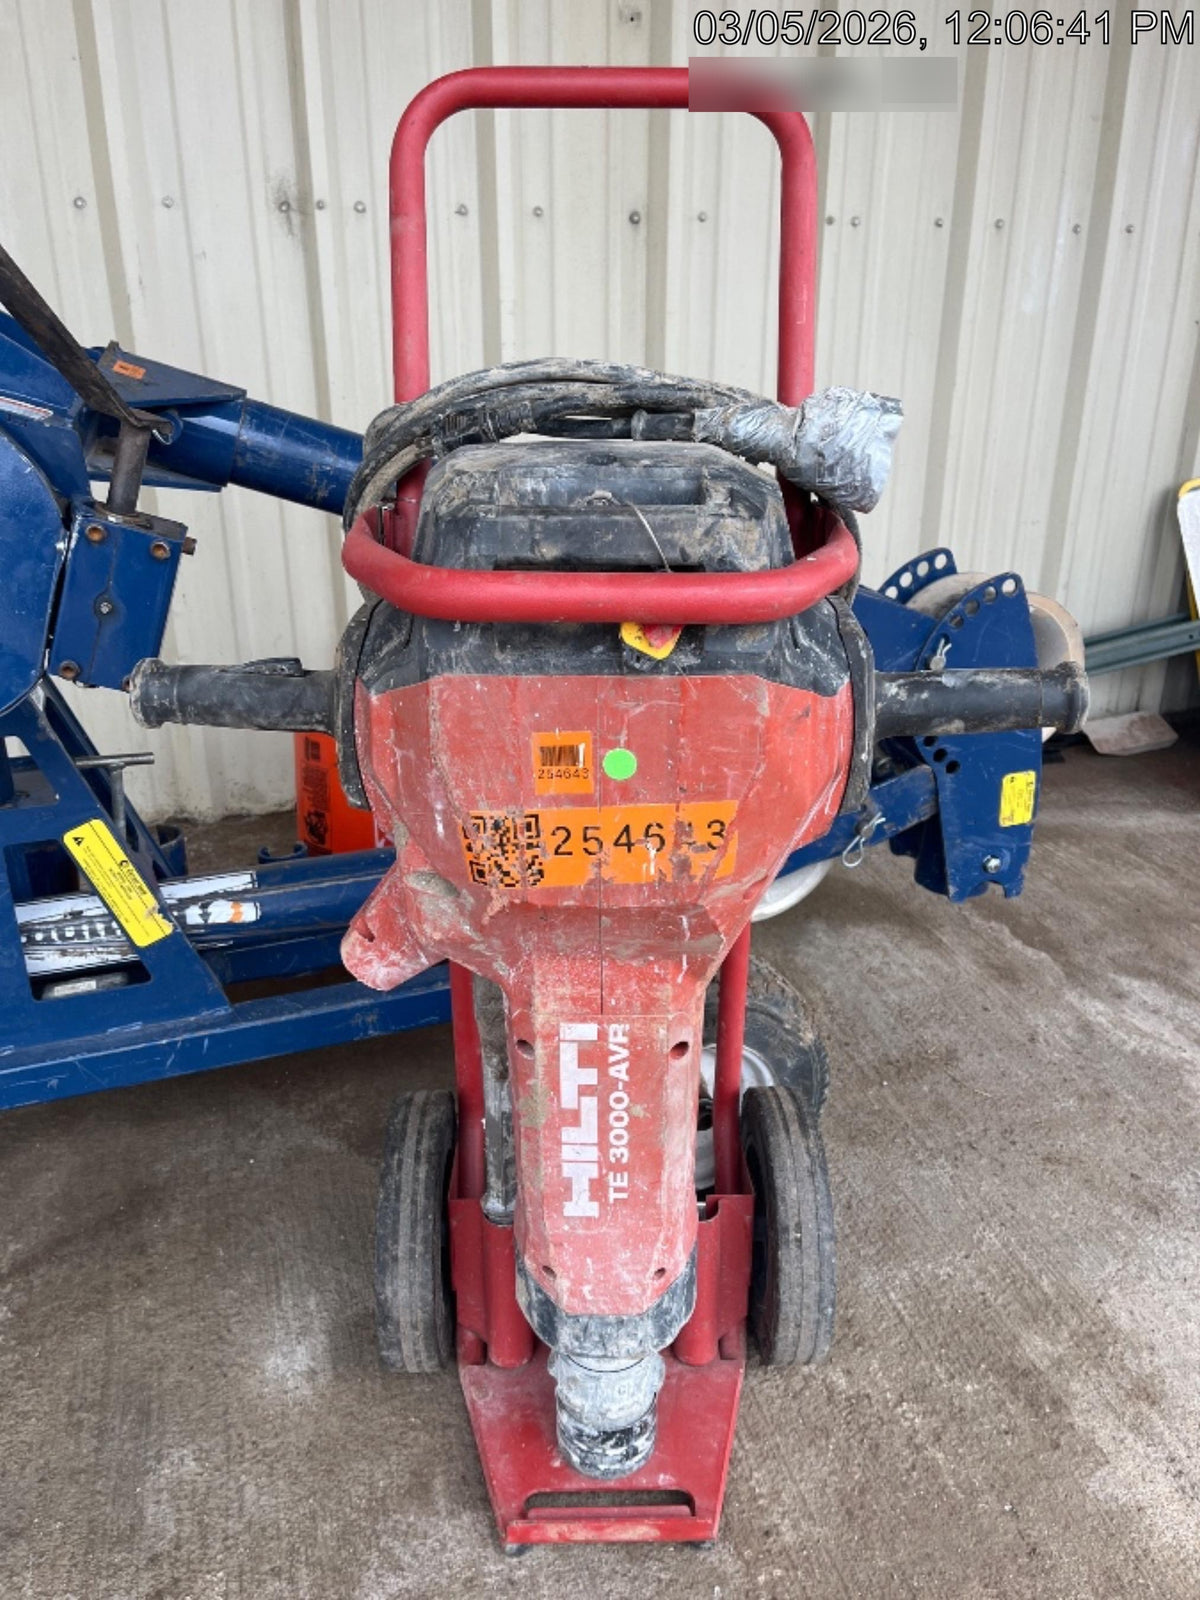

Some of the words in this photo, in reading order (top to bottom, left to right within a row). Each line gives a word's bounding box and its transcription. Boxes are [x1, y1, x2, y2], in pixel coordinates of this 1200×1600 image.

[538, 768, 590, 780] 254643
[551, 819, 727, 856] 25463
[608, 1023, 631, 1164] 3000-AVR
[559, 1022, 599, 1218] HILTI
[608, 1171, 630, 1204] TE
